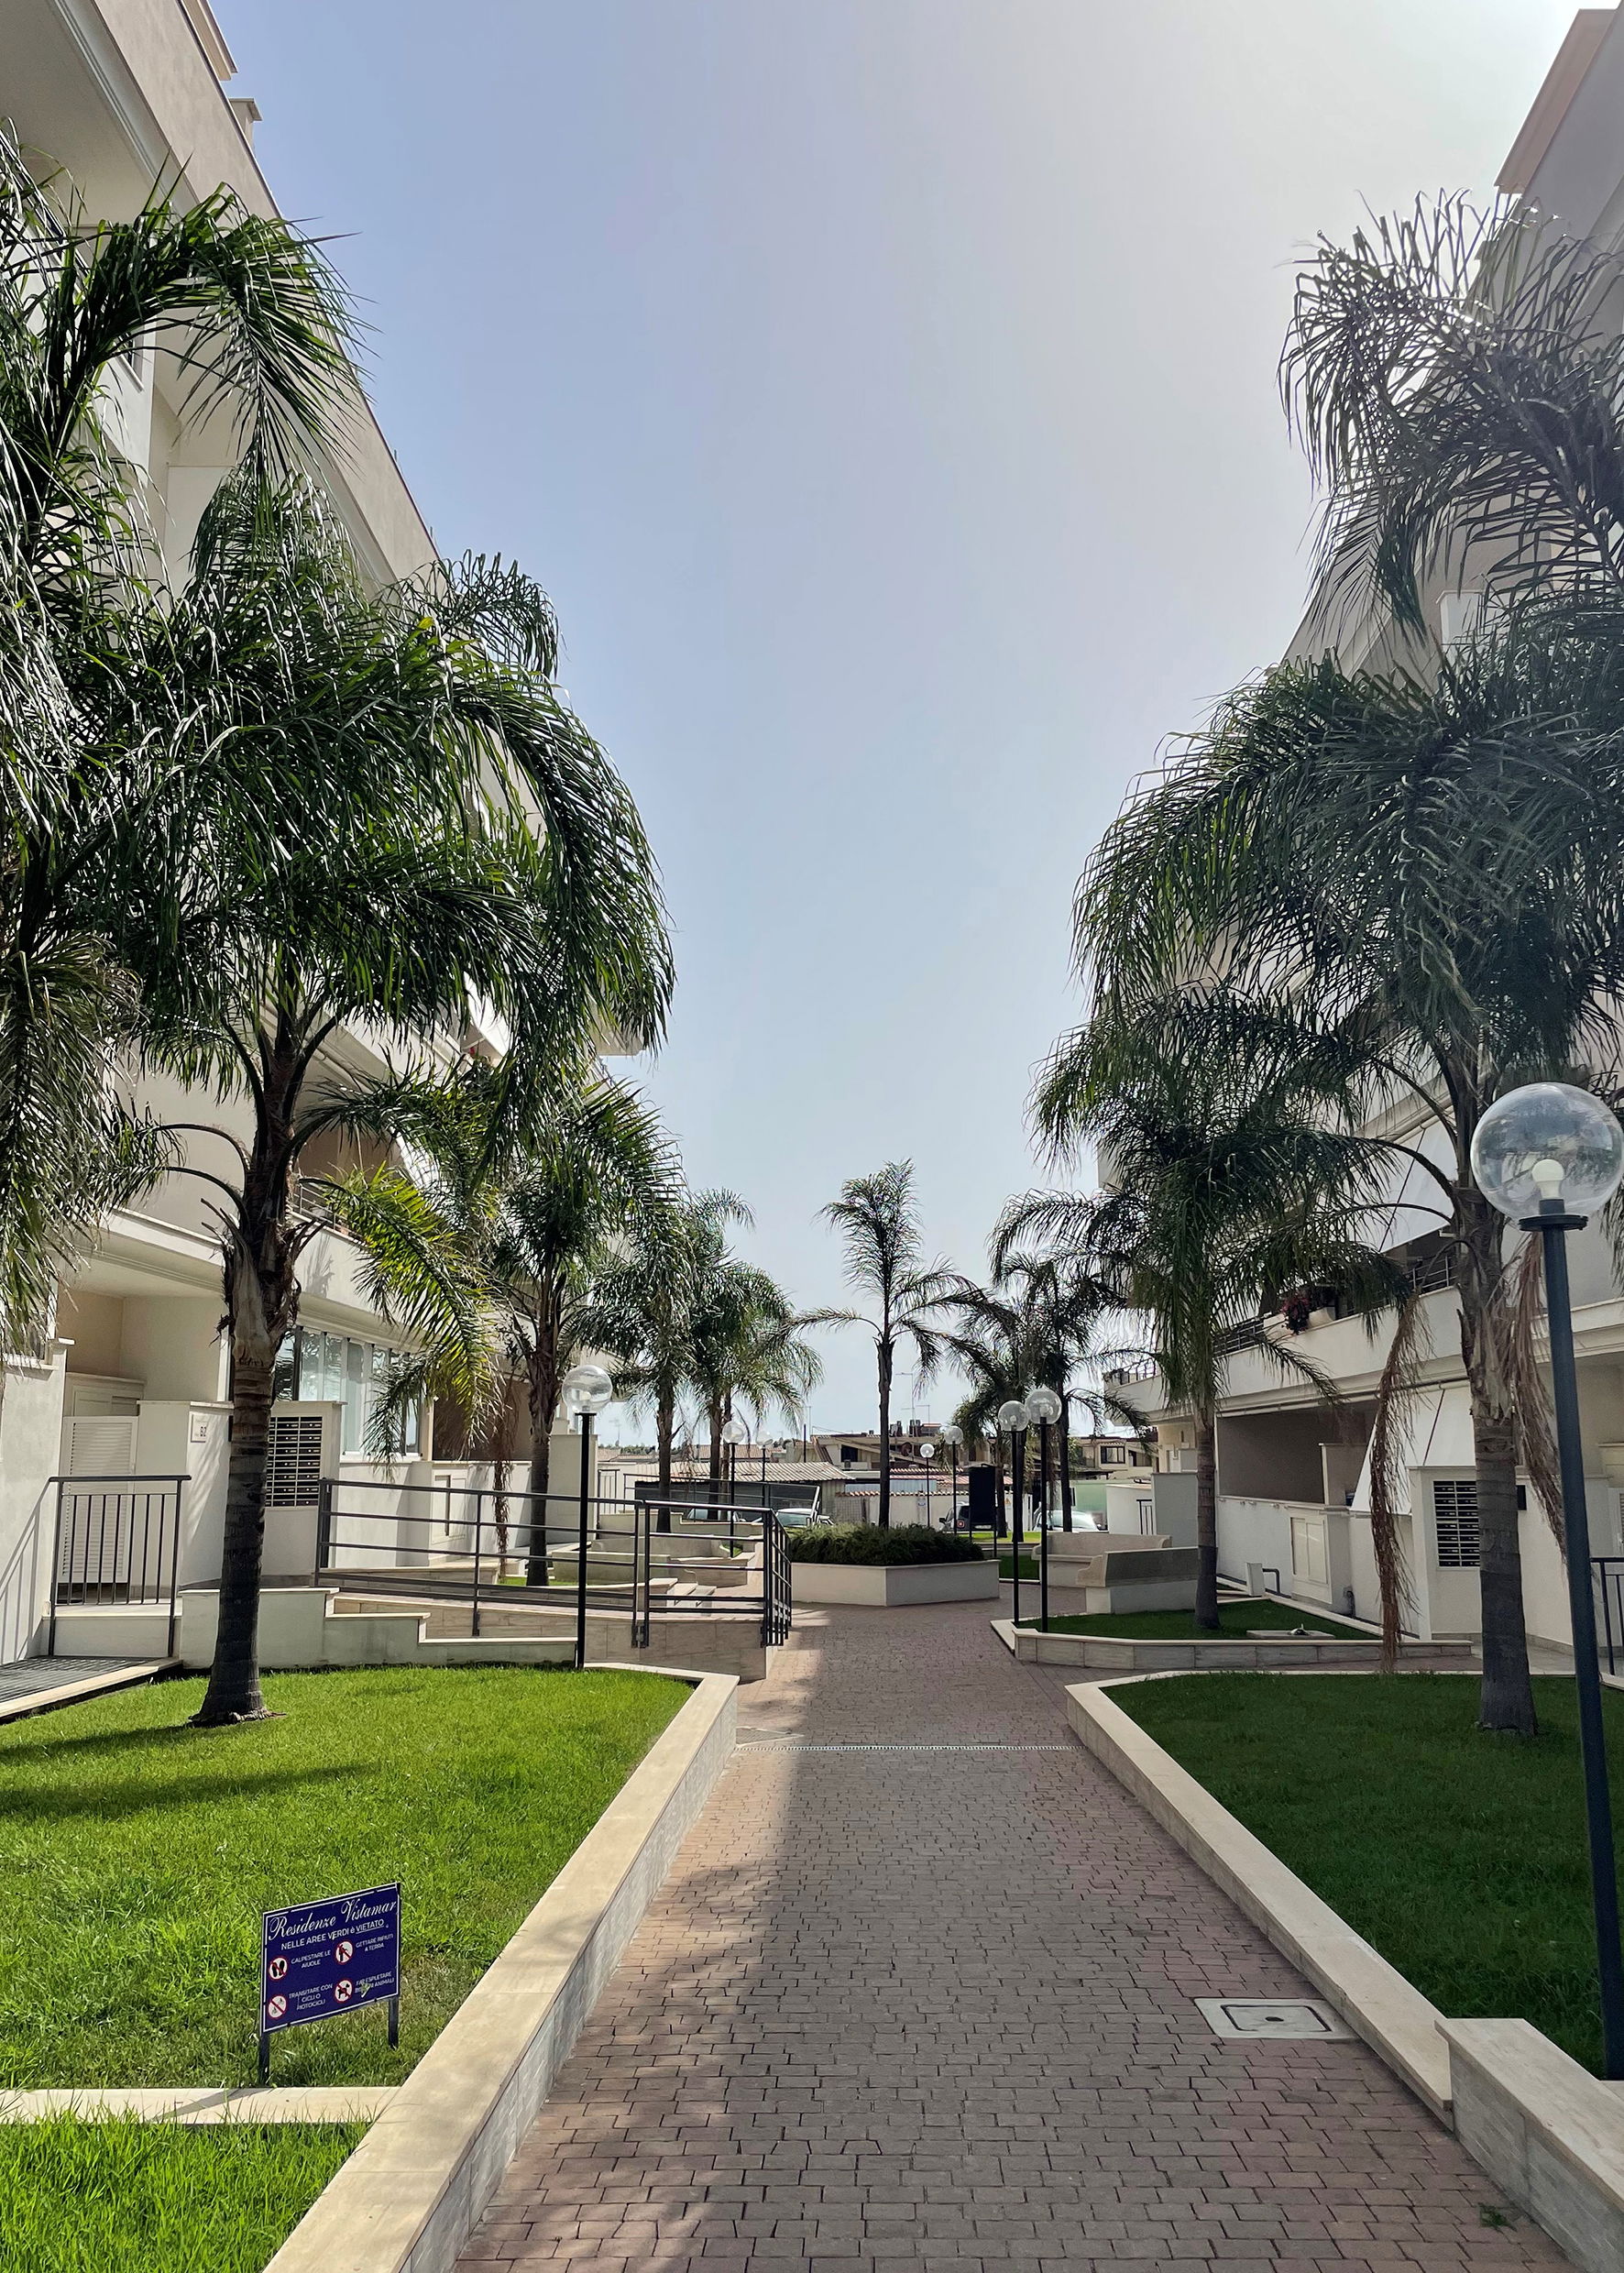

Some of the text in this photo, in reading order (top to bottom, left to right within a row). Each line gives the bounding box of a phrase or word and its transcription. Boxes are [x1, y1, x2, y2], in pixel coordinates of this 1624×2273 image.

[269, 1899, 396, 1940] Residenze Vistamar
[281, 1940, 304, 1950] NELLE
[306, 1934, 326, 1944] AREE
[327, 1928, 349, 1939] VERDI
[356, 1919, 384, 1932] VIETATO
[356, 1934, 393, 1948] GETTARE RIFIUTI
[291, 1952, 324, 1963] CALPESTARE
[302, 1960, 321, 1969] AIUOLE
[367, 1971, 391, 1982] ESPLETARE
[375, 1978, 394, 1988] ANIMALI
[289, 1983, 333, 1998] TRANSITARE CON
